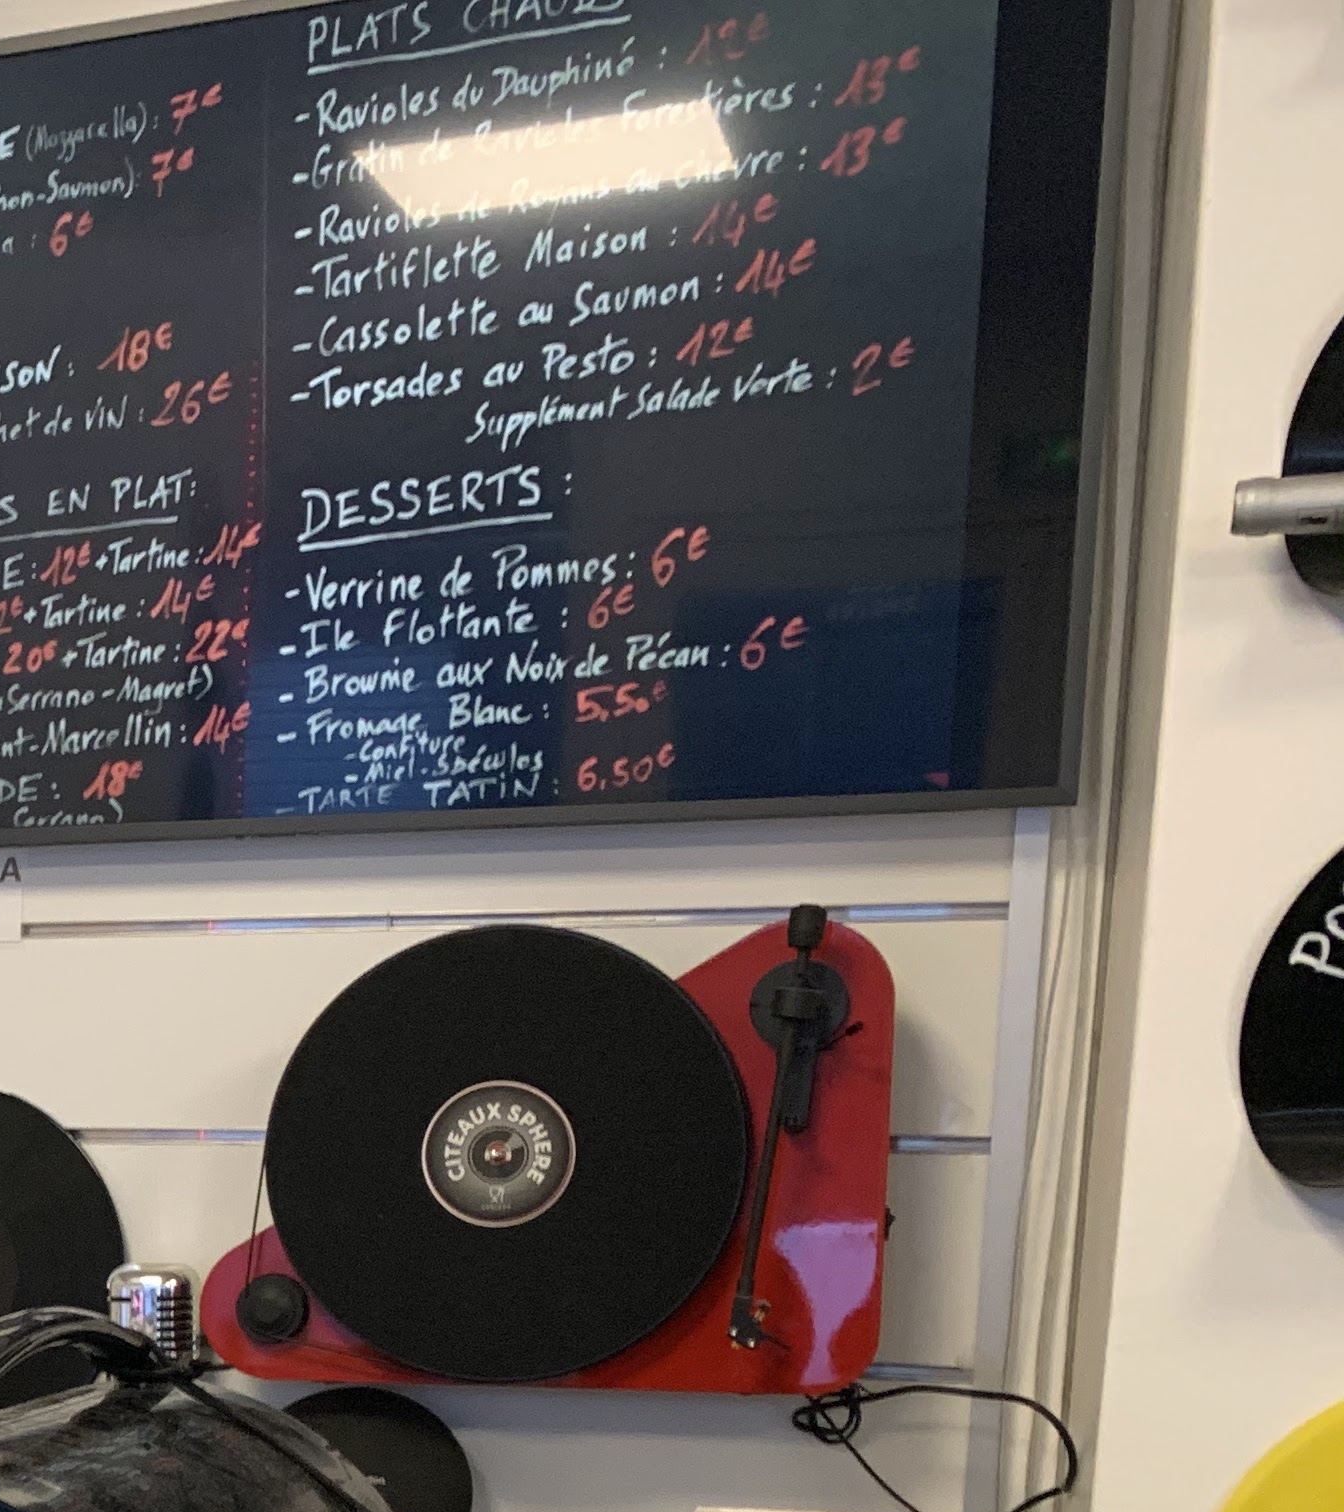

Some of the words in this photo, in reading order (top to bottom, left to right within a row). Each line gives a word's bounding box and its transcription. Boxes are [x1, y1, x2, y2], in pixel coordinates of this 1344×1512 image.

[307, 2, 431, 65] PLATS
[452, 79, 486, 117] du
[526, 225, 648, 271] Maison
[520, 306, 555, 329] au
[570, 277, 701, 326] Saumon
[736, 238, 817, 296] 14€
[98, 321, 173, 372] 18€
[483, 358, 524, 386] au
[543, 336, 637, 379] Pesto
[676, 316, 753, 368] 12€
[630, 375, 721, 418] Salade
[851, 336, 913, 396] 2€
[150, 371, 231, 429] 26€
[47, 482, 89, 515] EN
[298, 465, 543, 542] DESSERTS
[440, 561, 472, 594] de
[651, 525, 711, 587] 6€
[384, 609, 541, 647] Flottante
[587, 584, 636, 631] 6€
[437, 654, 492, 688] aux
[506, 645, 570, 684] Noix
[574, 644, 610, 678] de
[626, 629, 710, 671] Pécan
[740, 614, 808, 671] 6€
[449, 700, 532, 728] Blanc
[83, 759, 143, 800] 18€
[298, 781, 393, 814] TARTE
[444, 1101, 501, 1182] CITEAUX
[507, 1104, 553, 1185] SPHERE
